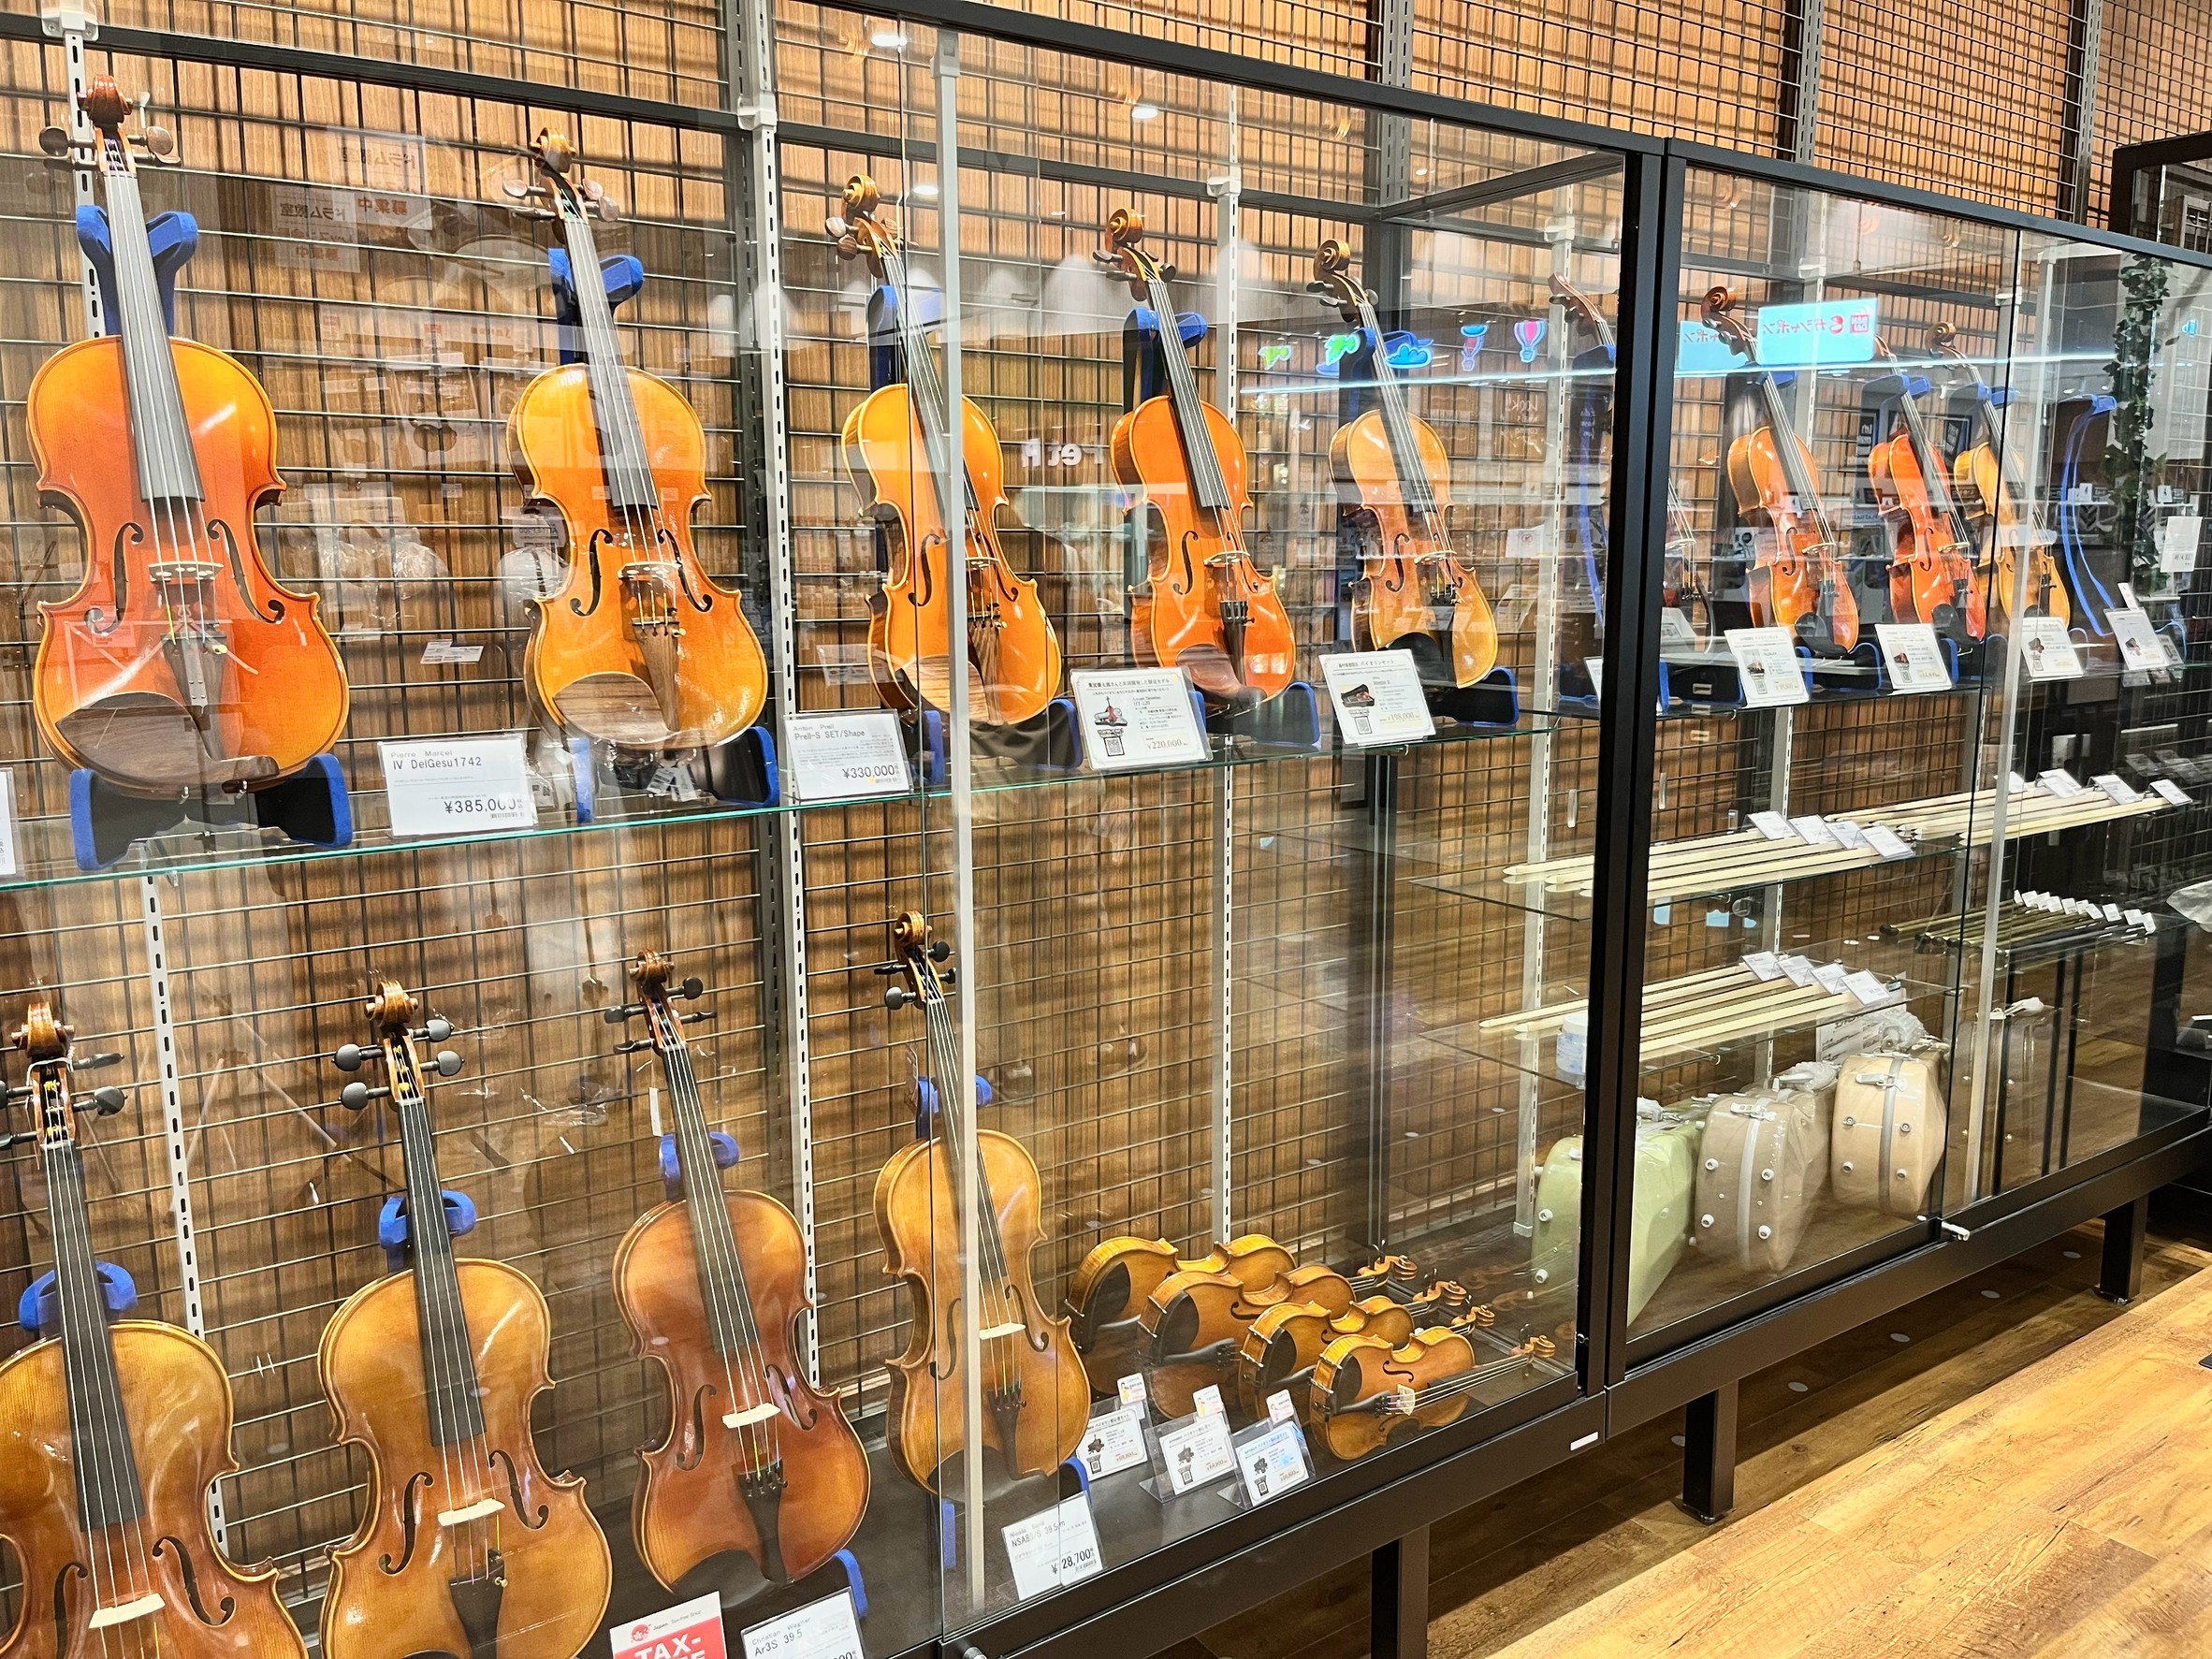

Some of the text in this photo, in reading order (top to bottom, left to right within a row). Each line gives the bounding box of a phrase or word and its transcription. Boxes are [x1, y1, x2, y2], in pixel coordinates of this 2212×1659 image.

[794, 730, 866, 740] Prell-S SET/Shape
[393, 756, 483, 770] IV DelGesu1742
[842, 764, 895, 779] ¥330,000
[751, 1630, 781, 1646] Christian
[787, 1618, 811, 1631] Wagner
[754, 1639, 779, 1657] Ar3S
[783, 1628, 803, 1644] 39.5
